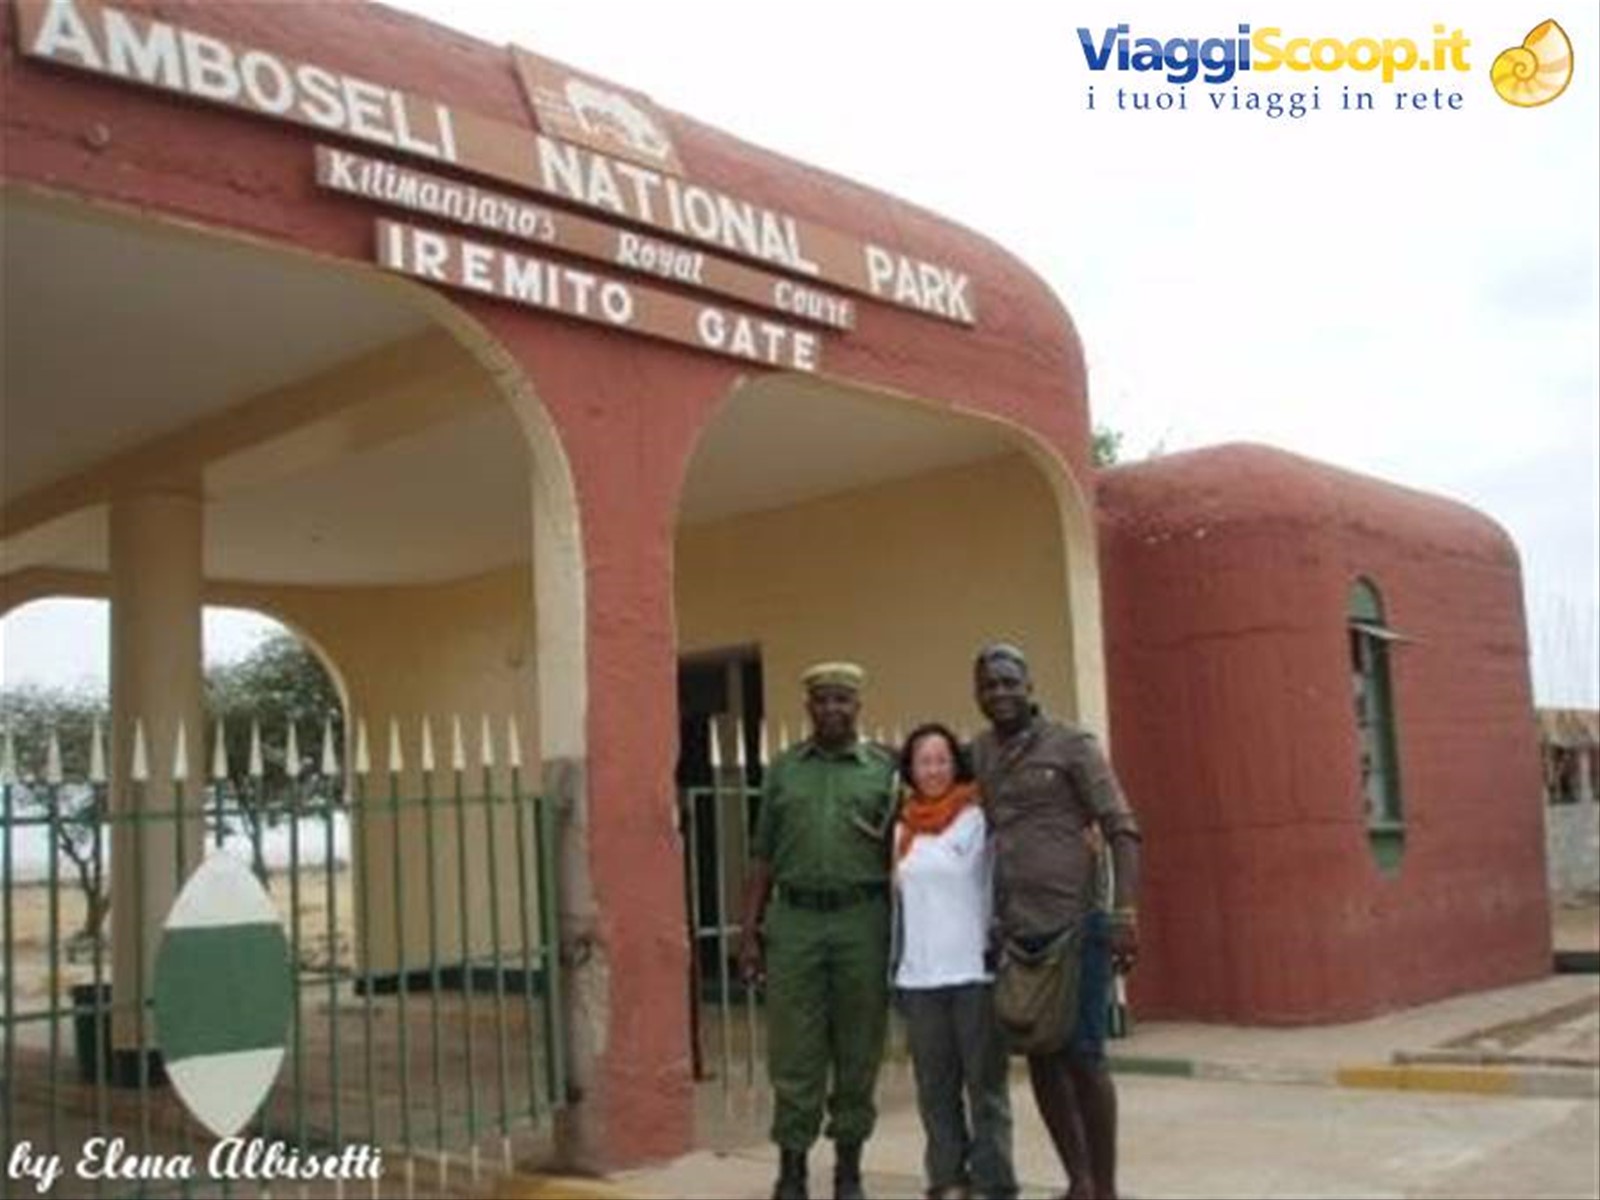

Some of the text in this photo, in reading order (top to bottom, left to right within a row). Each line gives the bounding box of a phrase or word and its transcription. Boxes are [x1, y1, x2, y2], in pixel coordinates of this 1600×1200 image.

[33, 0, 974, 323] AMBOSELI NATIONAL PARK
[388, 224, 820, 371] IREMITO GATE
[615, 232, 704, 284] Royal
[773, 280, 850, 327] Court
